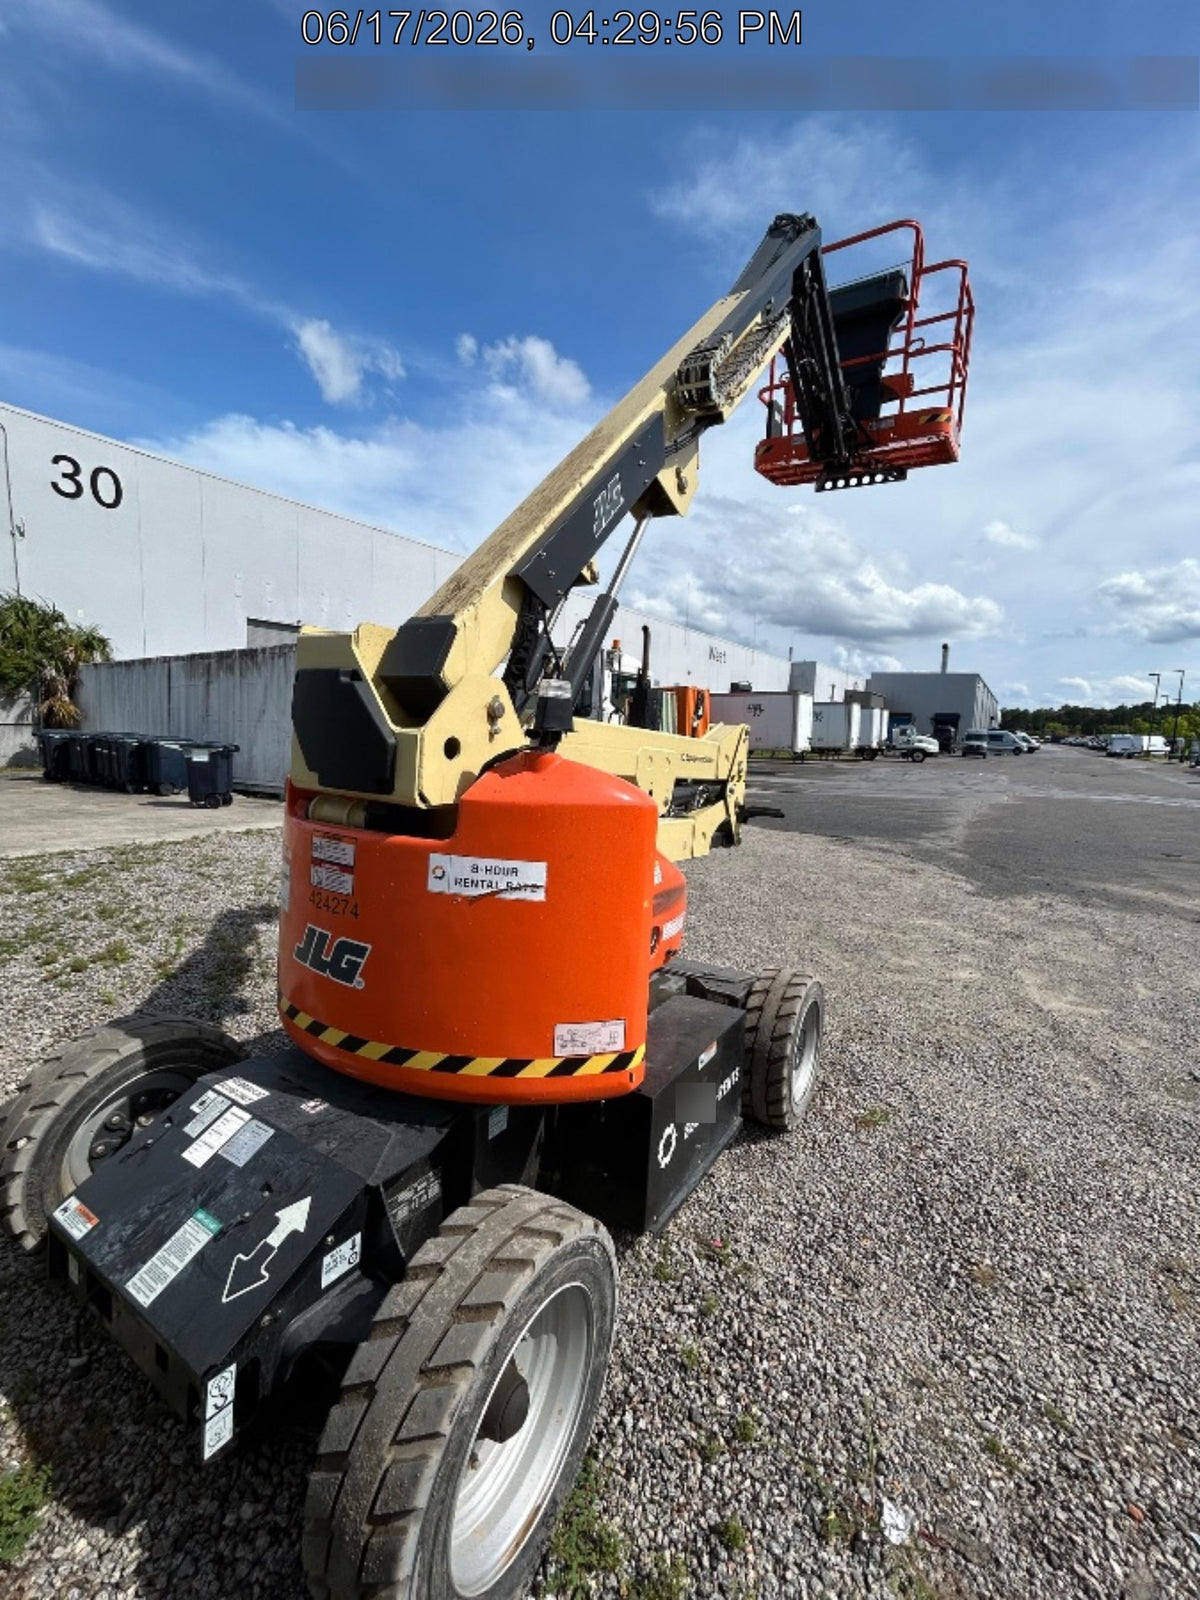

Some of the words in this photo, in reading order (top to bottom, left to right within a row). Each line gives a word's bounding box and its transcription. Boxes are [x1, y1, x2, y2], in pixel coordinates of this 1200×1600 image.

[50, 454, 123, 510] 30
[453, 877, 499, 890] RENTAL
[470, 863, 519, 877] 8-HOUR
[308, 890, 360, 920] 424274
[293, 922, 372, 989] JLG
